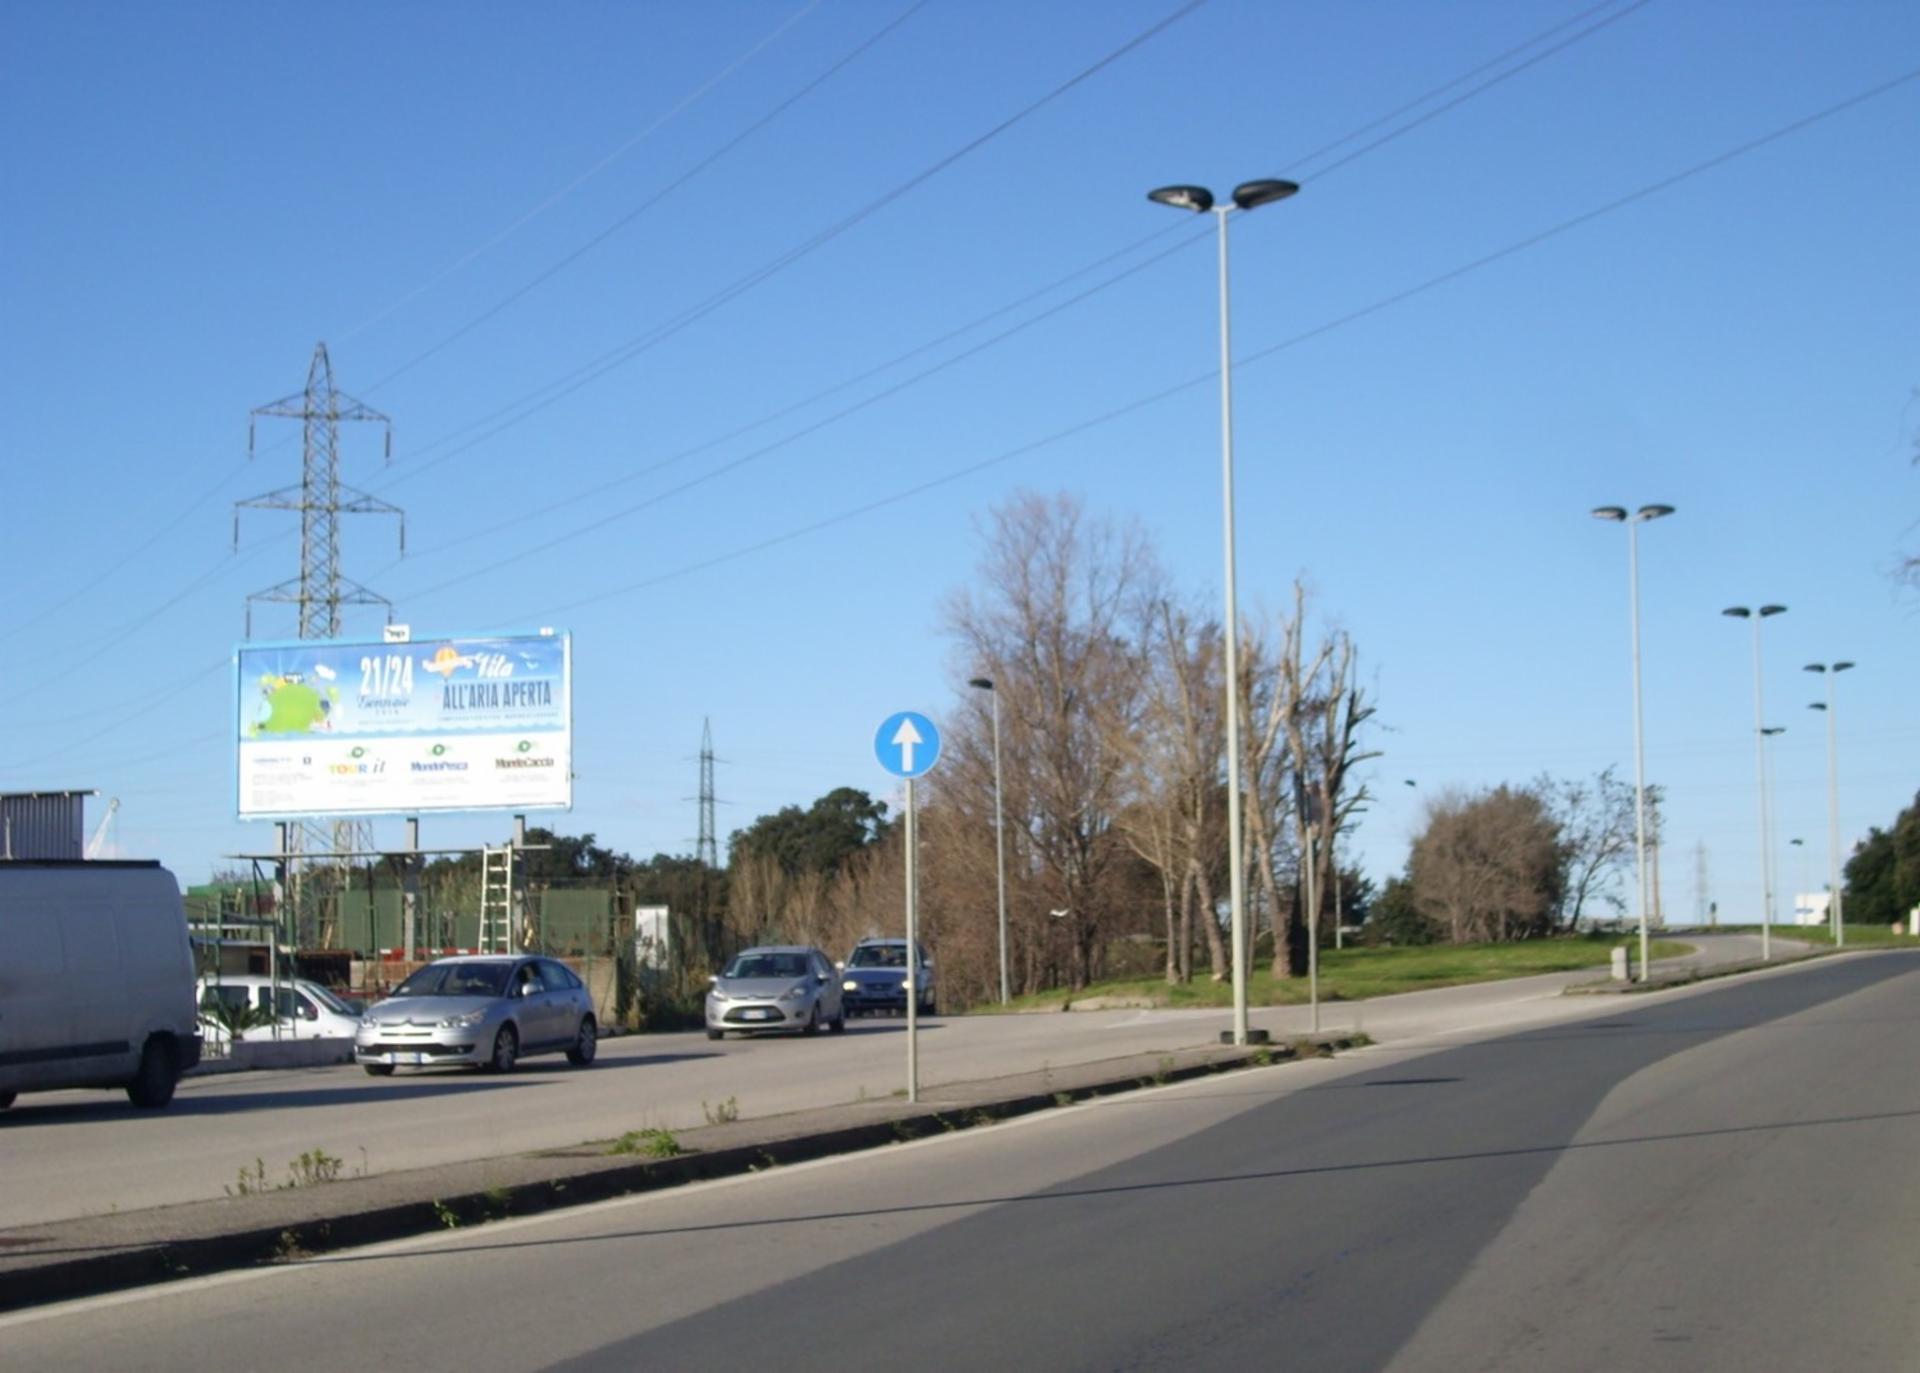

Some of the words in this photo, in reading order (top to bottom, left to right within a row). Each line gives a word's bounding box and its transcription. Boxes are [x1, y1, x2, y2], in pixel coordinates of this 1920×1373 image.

[360, 654, 413, 696] 21/24
[442, 682, 499, 710] ALL'ARIA
[502, 680, 552, 708] APERTA
[328, 763, 368, 776] TOUR
